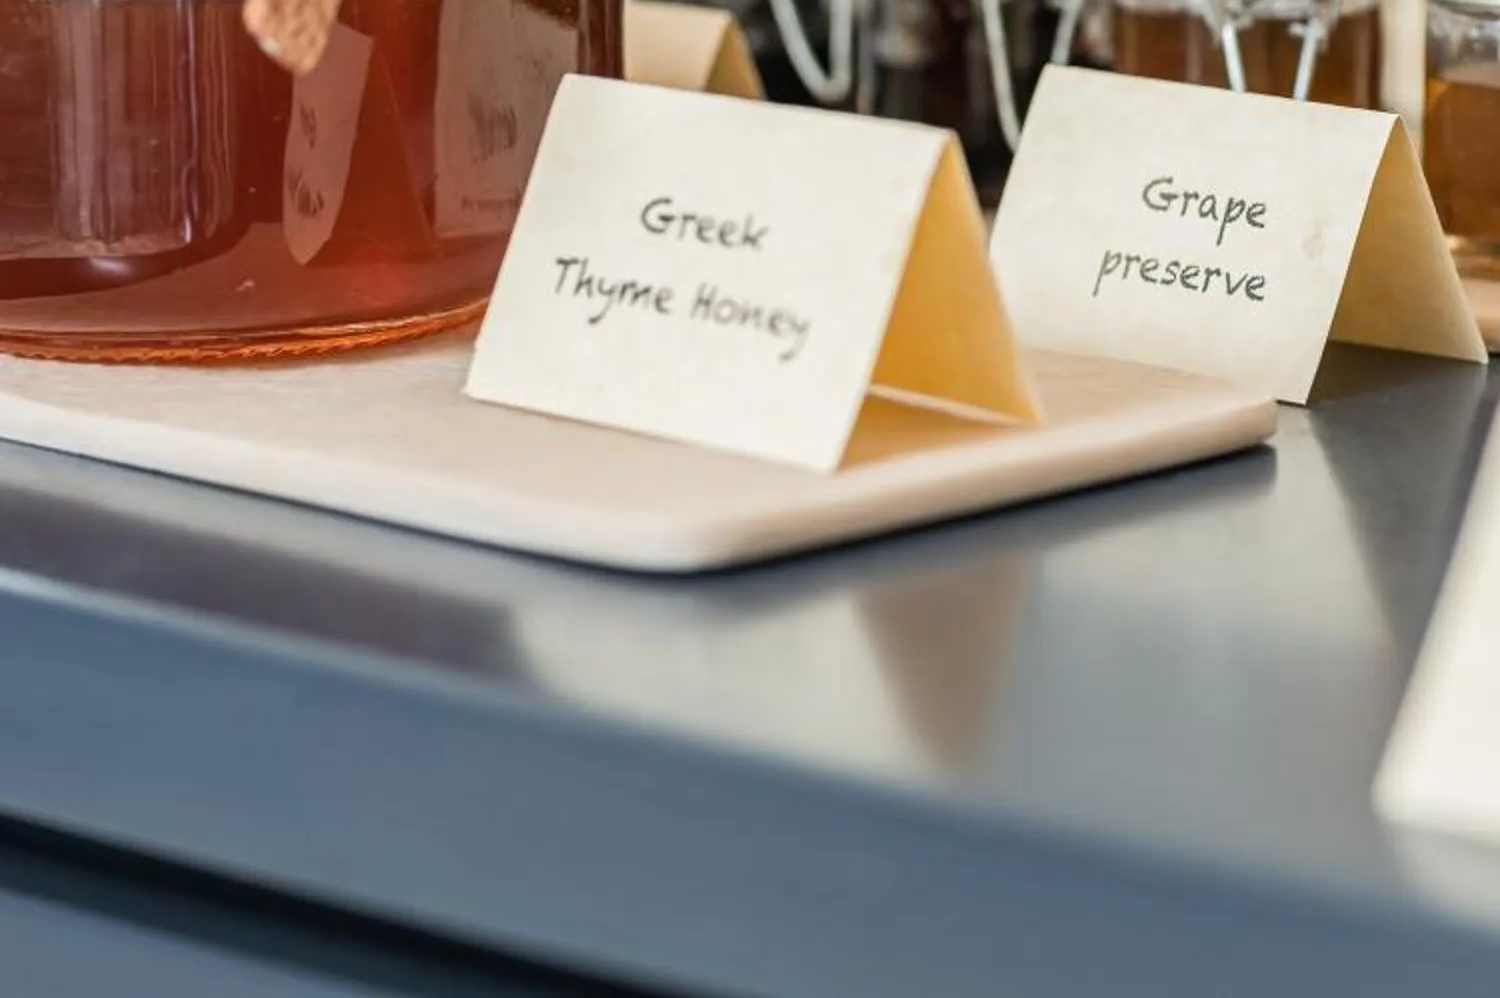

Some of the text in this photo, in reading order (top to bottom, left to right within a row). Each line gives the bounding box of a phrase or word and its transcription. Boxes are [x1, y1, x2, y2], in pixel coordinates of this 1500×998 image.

[640, 197, 769, 250] Greek
[1141, 176, 1267, 246] Grape
[1092, 248, 1267, 302] preserve
[552, 256, 811, 363] Thyme Honey
